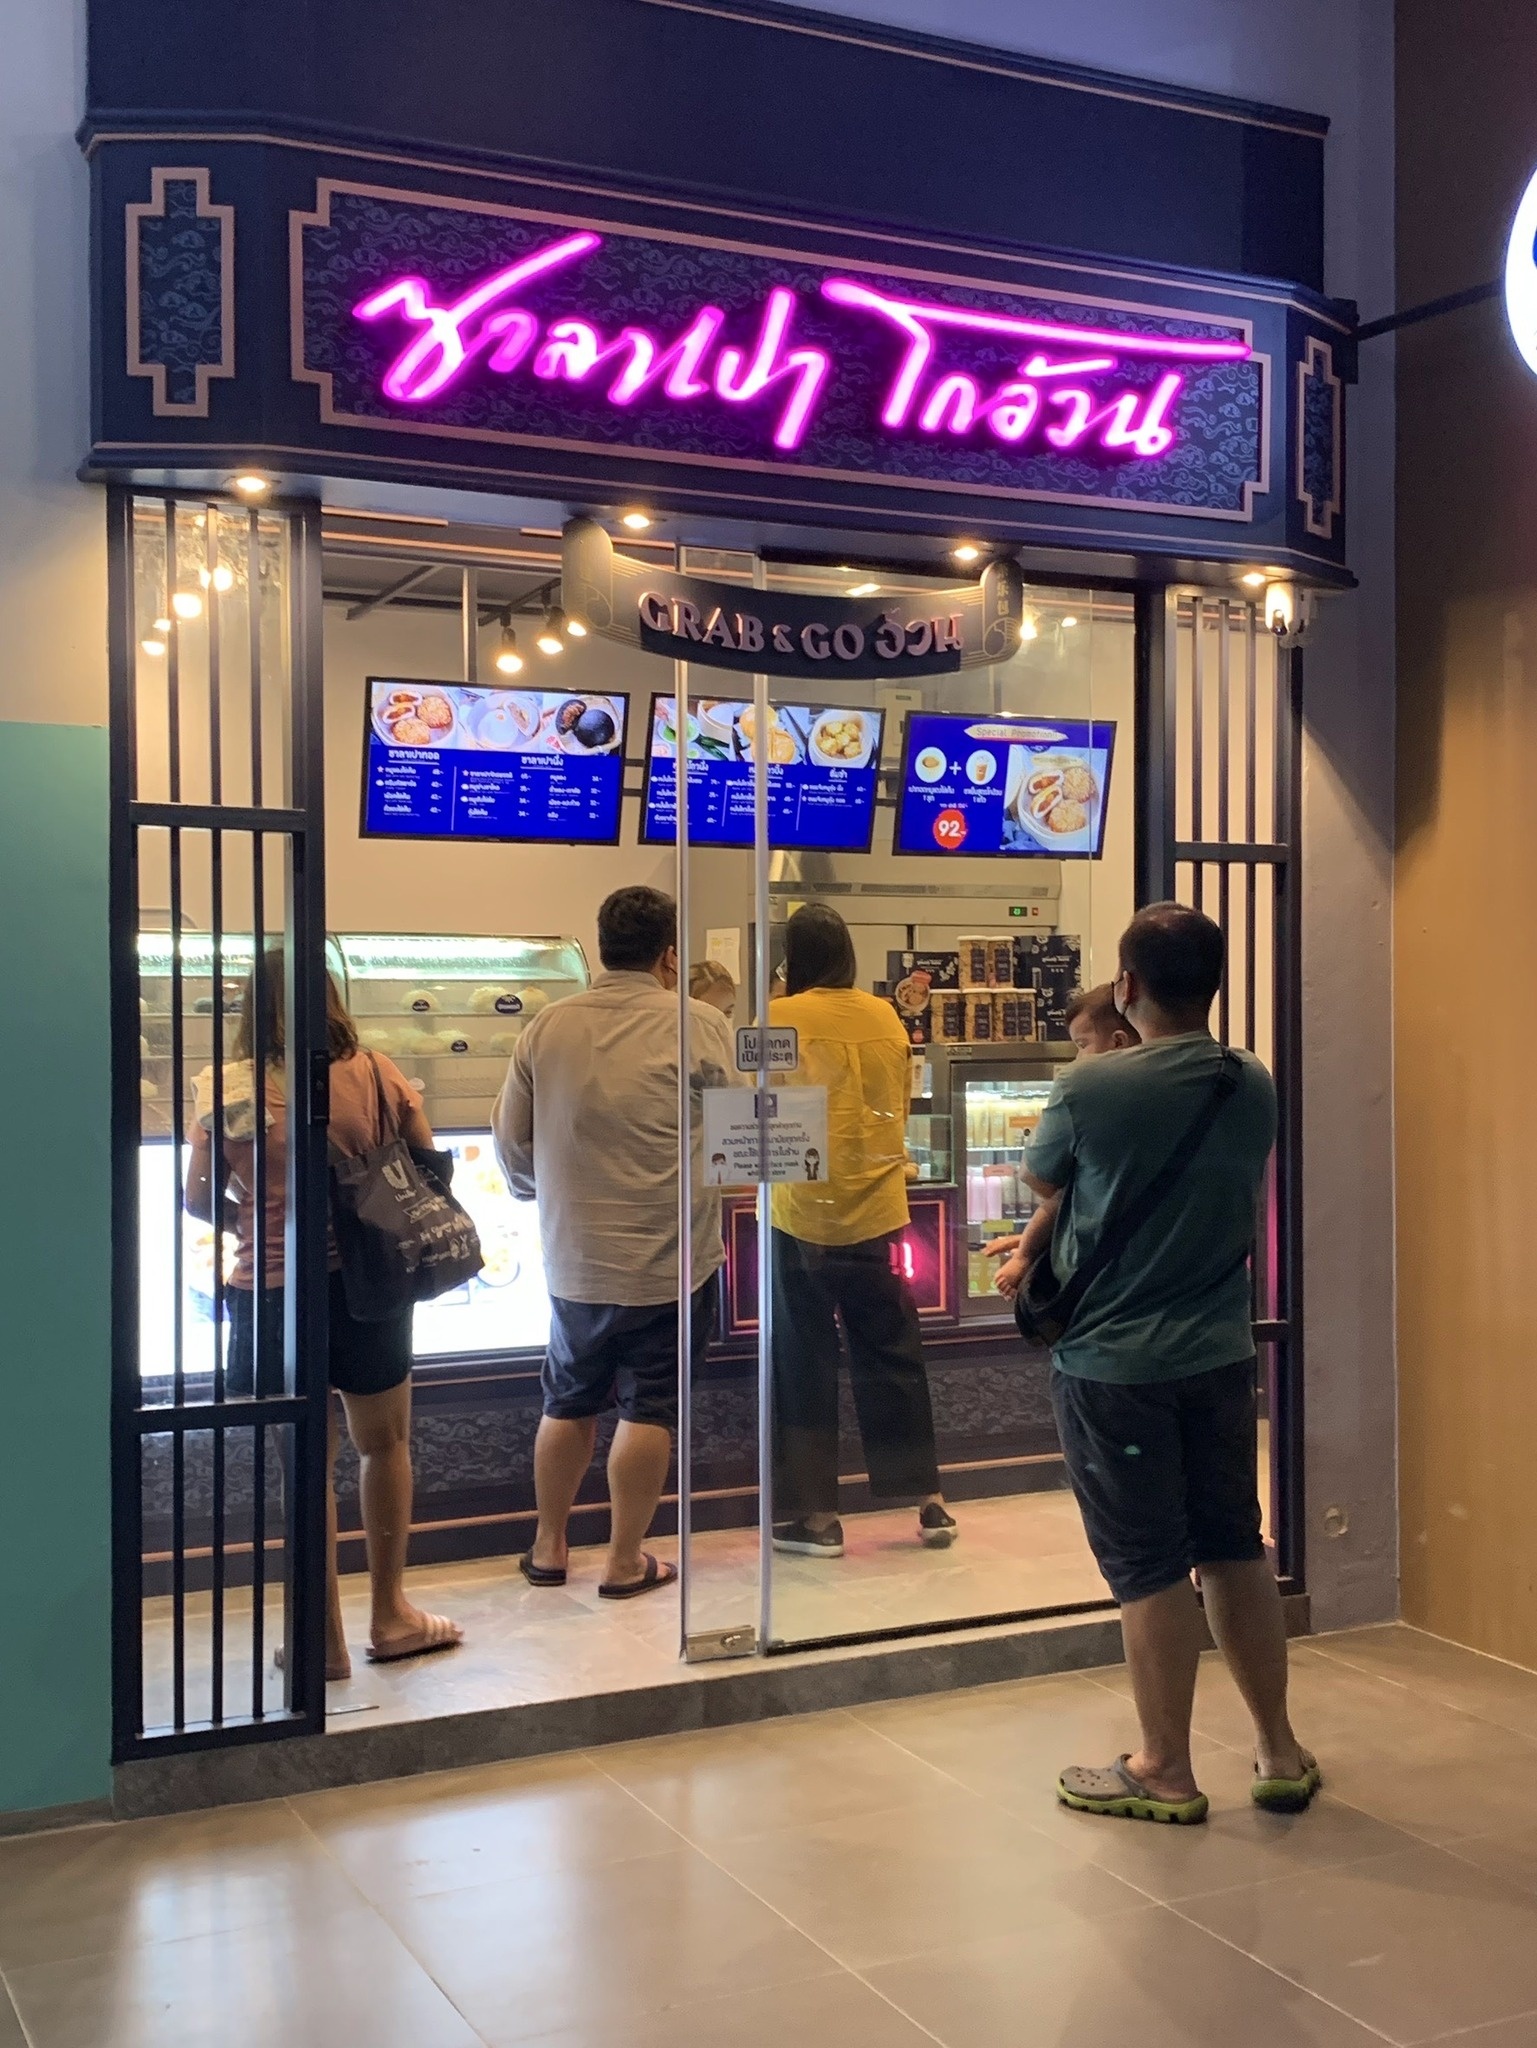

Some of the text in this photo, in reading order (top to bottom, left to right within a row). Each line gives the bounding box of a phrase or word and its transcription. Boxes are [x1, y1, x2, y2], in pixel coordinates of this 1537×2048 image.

[638, 591, 765, 653] GRAB
[772, 623, 796, 653] &
[800, 622, 865, 660] GO
